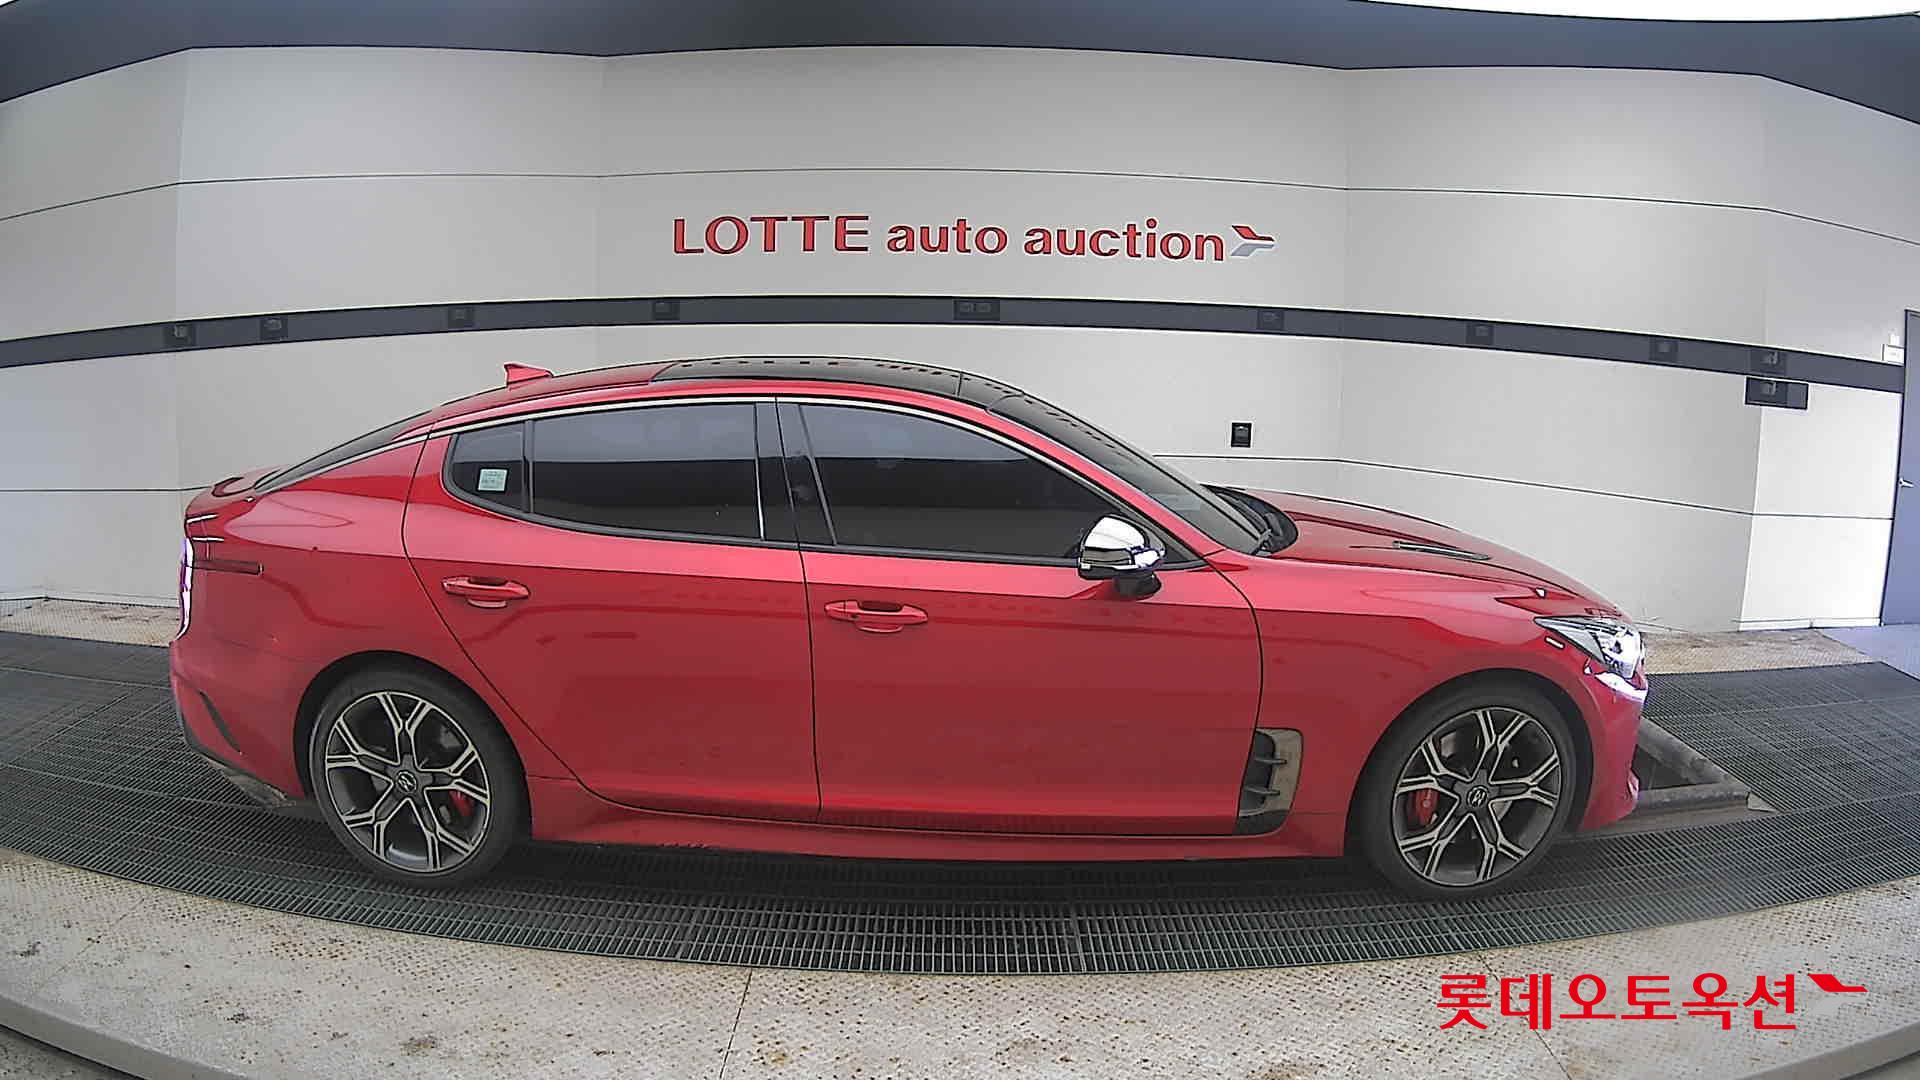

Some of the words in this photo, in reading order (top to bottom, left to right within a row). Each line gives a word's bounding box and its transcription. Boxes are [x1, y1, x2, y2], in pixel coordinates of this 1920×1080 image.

[673, 214, 870, 255] LOTTE
[886, 218, 1009, 254] auto
[1023, 217, 1225, 262] auction
